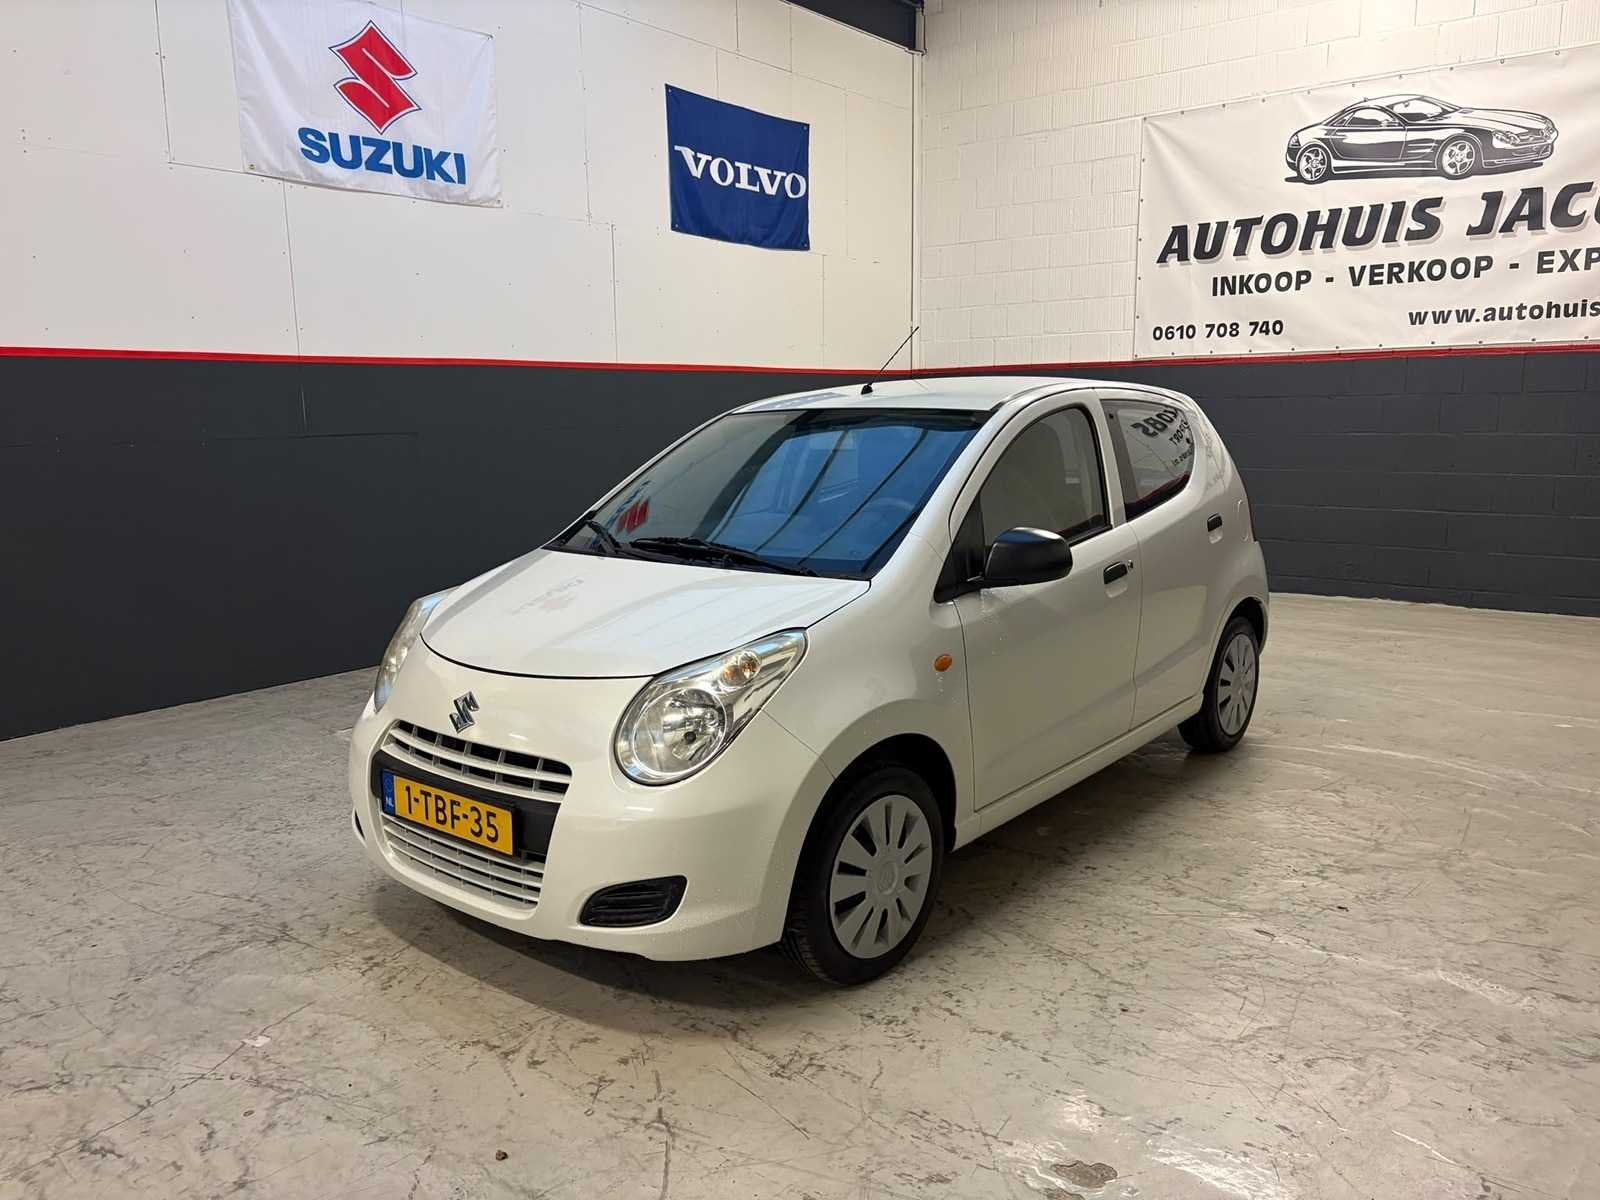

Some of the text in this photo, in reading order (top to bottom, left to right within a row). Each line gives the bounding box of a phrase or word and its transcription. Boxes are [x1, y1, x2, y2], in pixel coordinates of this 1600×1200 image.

[297, 127, 467, 185] SUZUKI
[674, 145, 807, 199] VOLVO
[1156, 182, 1600, 265] AUTOHUIS JAC
[1212, 270, 1312, 297] INKOOP
[1348, 255, 1494, 287] VERKOOP
[1509, 262, 1520, 270] -
[1536, 247, 1600, 275] EXP
[1152, 319, 1284, 341] 0610 708 740
[1408, 299, 1600, 326] www.autohuis
[385, 785, 499, 843] NL 1-TBF-35
